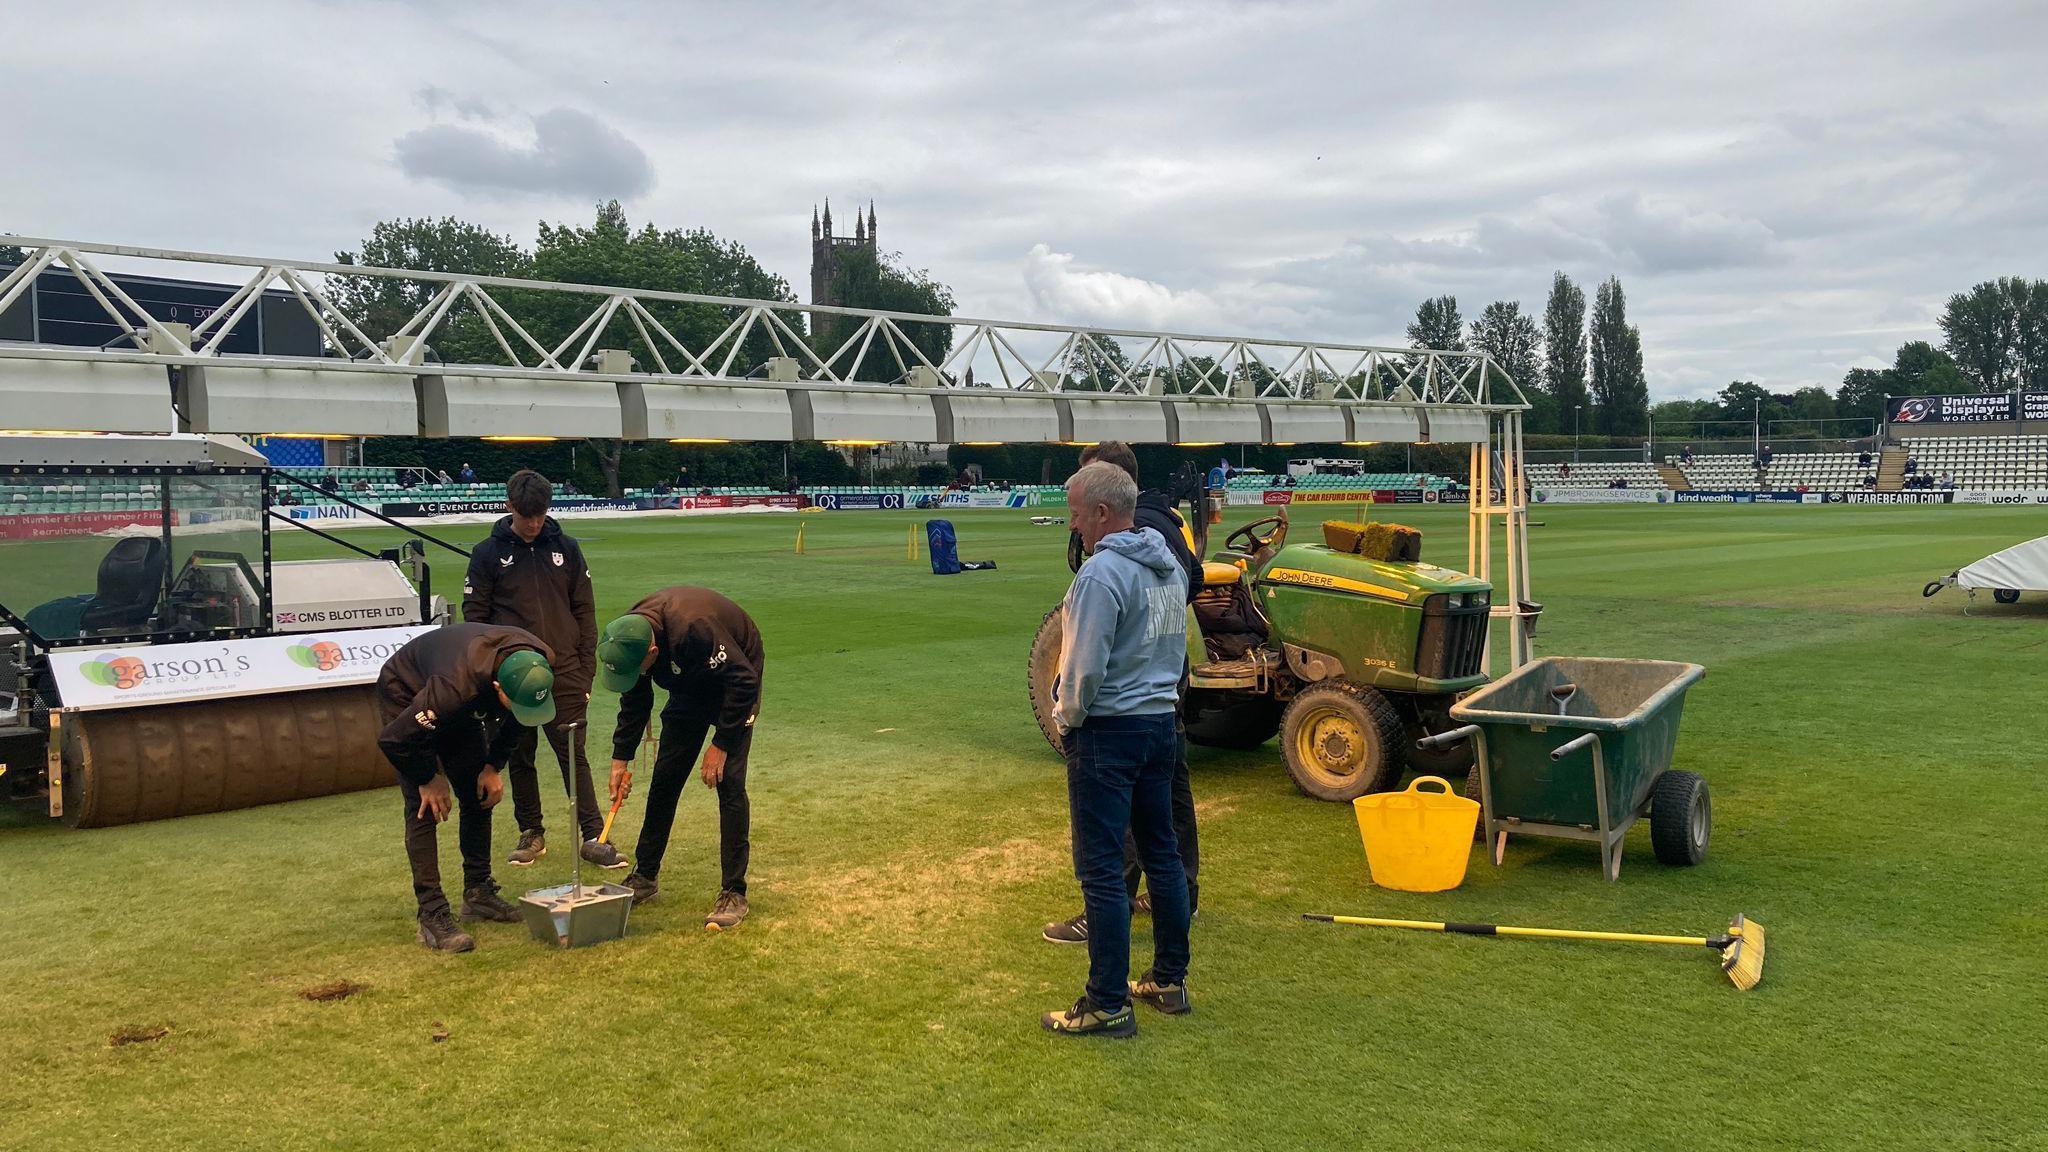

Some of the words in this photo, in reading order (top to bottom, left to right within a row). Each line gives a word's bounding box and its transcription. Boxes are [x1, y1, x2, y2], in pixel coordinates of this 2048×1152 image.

[1942, 395, 2010, 406] Universal
[1942, 405, 1995, 416] Display
[2025, 403, 2048, 411] Grap
[1306, 493, 1319, 501] CAR
[1320, 493, 1345, 501] REFURB
[1346, 492, 1371, 501] CENTRE
[1677, 494, 1699, 503] kind
[1700, 494, 1734, 503] wealth
[1847, 493, 1944, 504] WEAREBEARD.COM
[418, 504, 426, 512] A
[428, 503, 436, 512] C
[440, 503, 468, 511] EVENT
[471, 502, 508, 511] CATERIN
[1276, 570, 1301, 583] JOHN
[1302, 573, 1334, 586] DEERE
[298, 612, 325, 623] CMS
[329, 608, 382, 621] BLOTTER
[385, 606, 405, 618] LTD
[313, 632, 412, 671] garson'
[111, 647, 250, 690] garson's
[143, 675, 200, 685] GROUP
[213, 671, 241, 679] LTD
[1106, 1015, 1129, 1027] SCOTT
